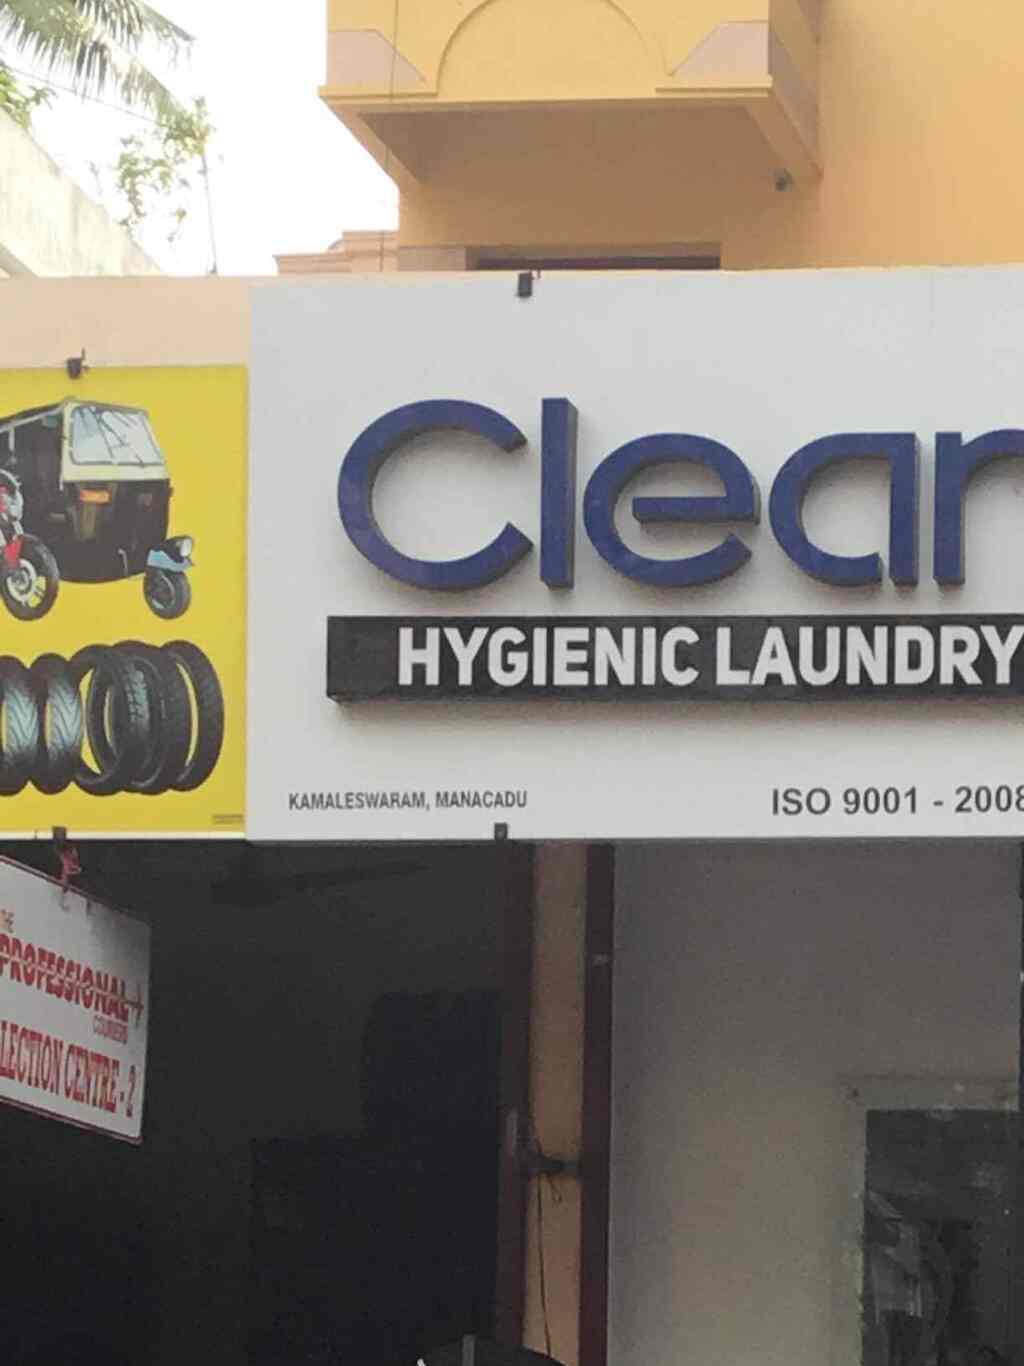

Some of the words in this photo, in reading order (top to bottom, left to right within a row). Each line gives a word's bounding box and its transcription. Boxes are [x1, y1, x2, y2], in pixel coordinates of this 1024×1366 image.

[397, 626, 700, 687] HYGIENIC
[288, 792, 431, 811] KAMALESWARAM,
[434, 790, 528, 808] MANACADU
[772, 787, 831, 815] ISO
[842, 787, 918, 815] 9001
[64, 1043, 120, 1113] CENTRE
